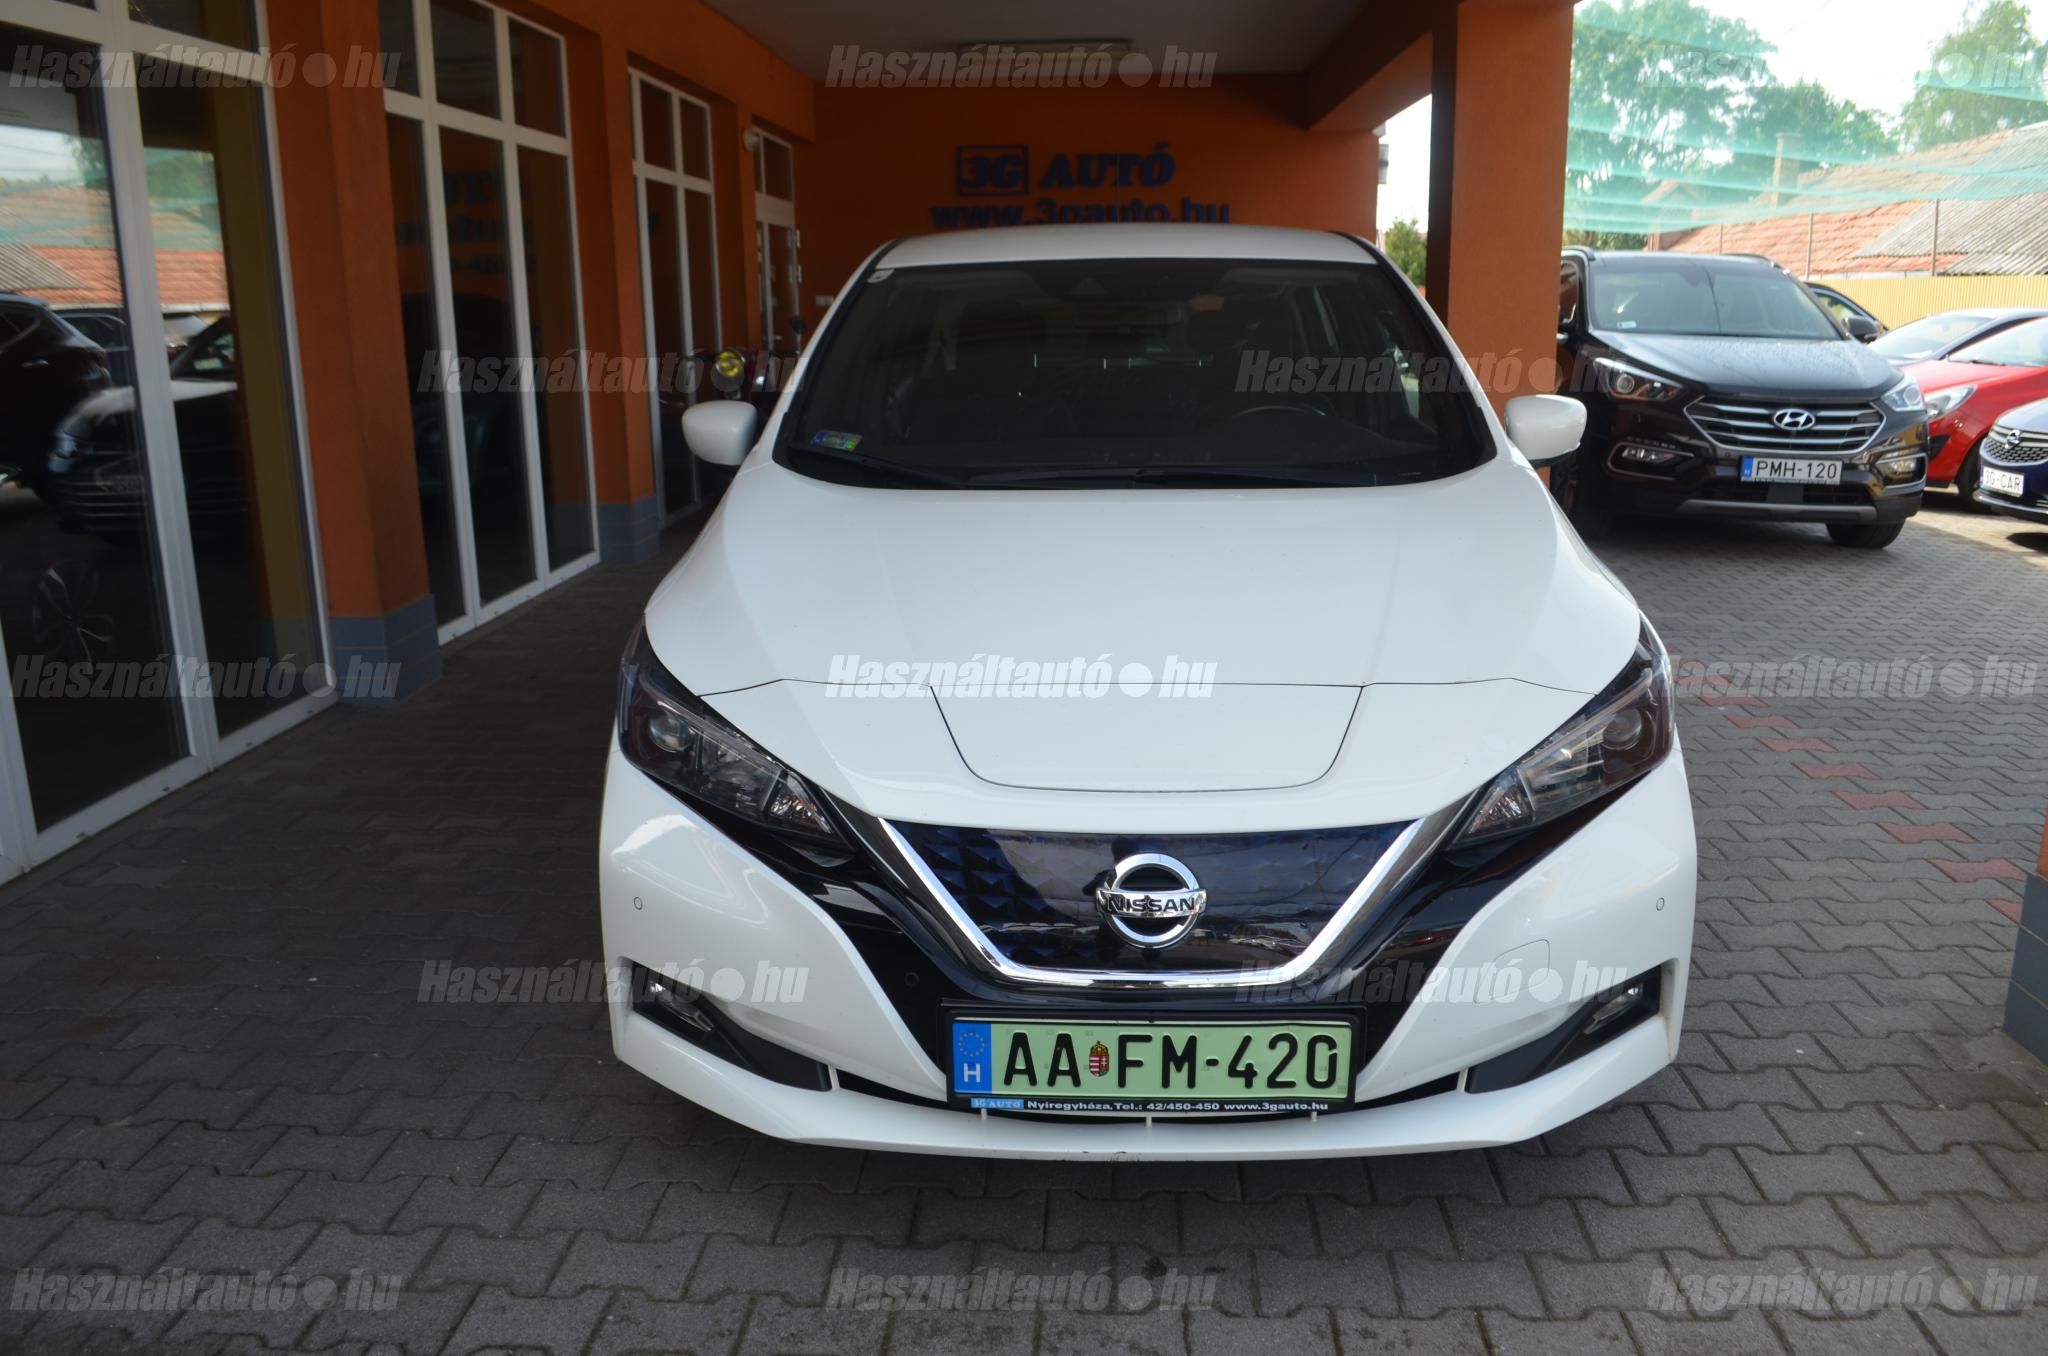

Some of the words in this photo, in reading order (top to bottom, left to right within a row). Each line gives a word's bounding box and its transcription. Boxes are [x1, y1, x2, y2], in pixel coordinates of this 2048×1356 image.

[960, 154, 1025, 190] 3G
[1039, 140, 1175, 189] AUTÓ
[1756, 460, 1837, 479] PMH-120
[1107, 894, 1195, 912] NISSAN
[962, 1063, 982, 1084] H
[1146, 1102, 1220, 1111] 42/450-450
[1223, 1102, 1329, 1112] www.3gauto.hu
